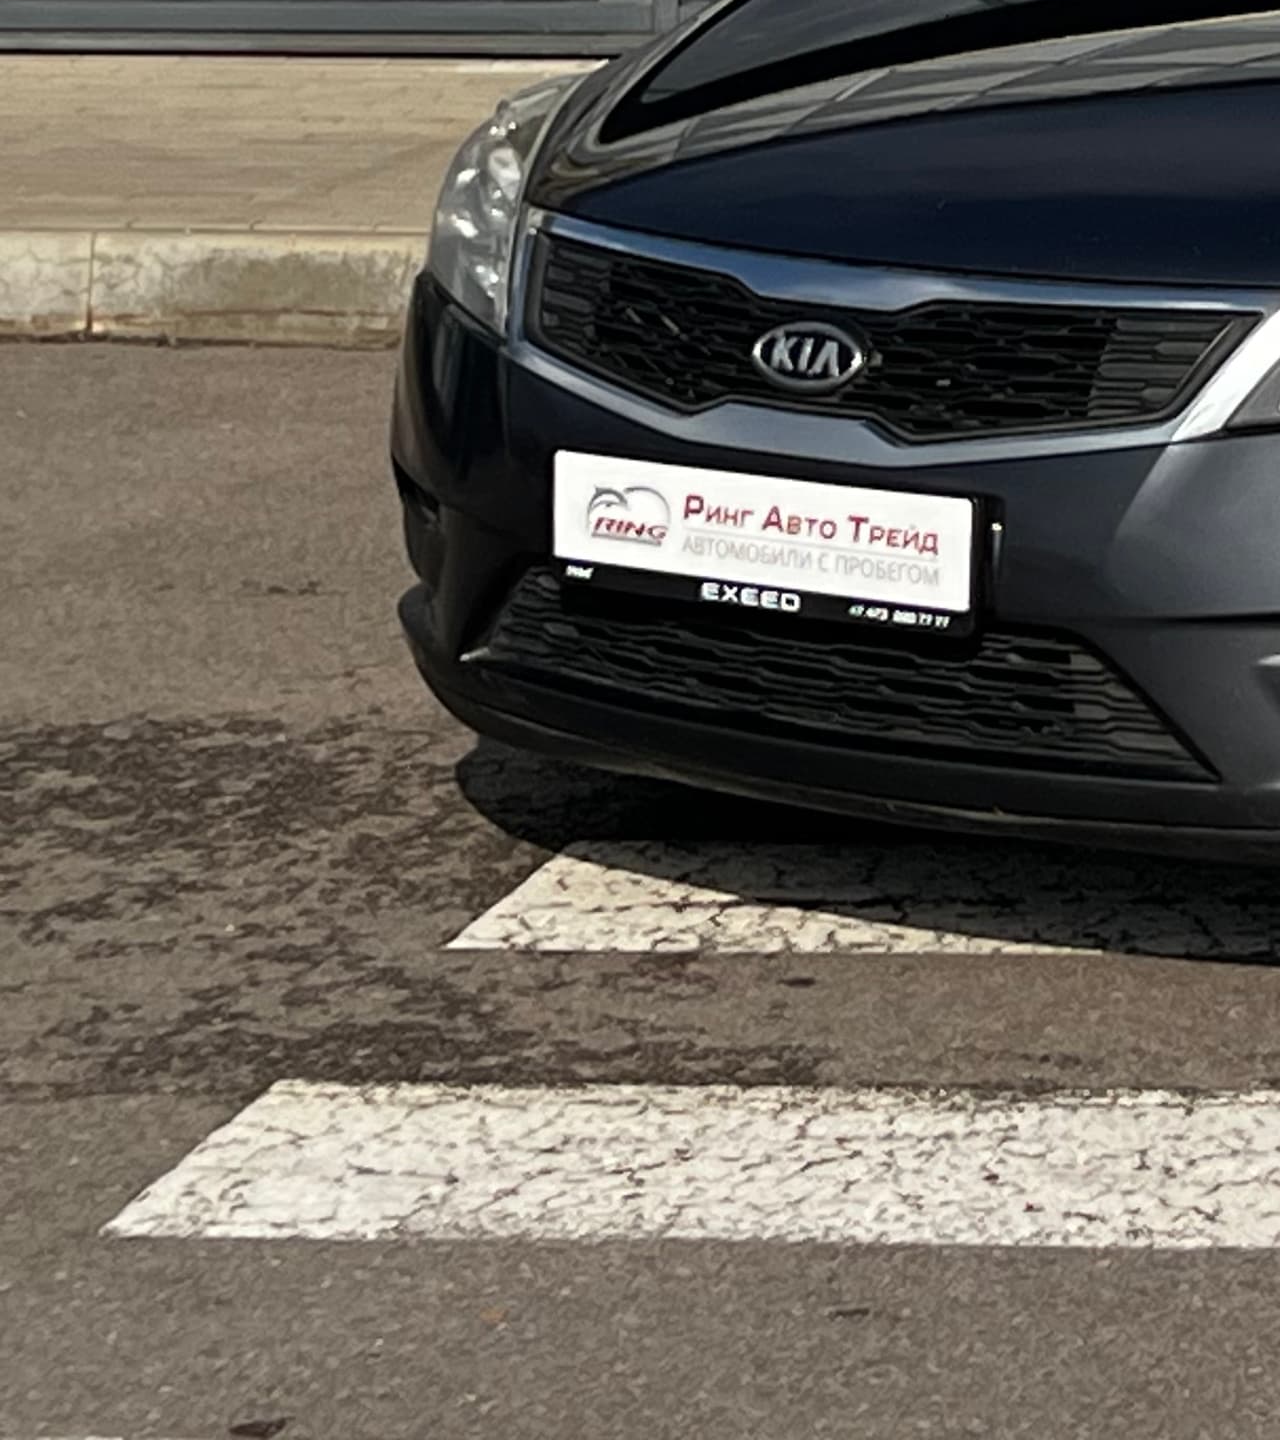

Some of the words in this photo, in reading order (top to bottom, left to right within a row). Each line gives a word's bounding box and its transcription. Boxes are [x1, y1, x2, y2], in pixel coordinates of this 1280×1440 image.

[770, 332, 840, 378] KIA
[594, 515, 669, 540] RING
[682, 534, 812, 570] АВТОМОБИЛИ
[834, 553, 940, 586] ПРОБЕГОМ
[701, 580, 801, 612] EXEED
